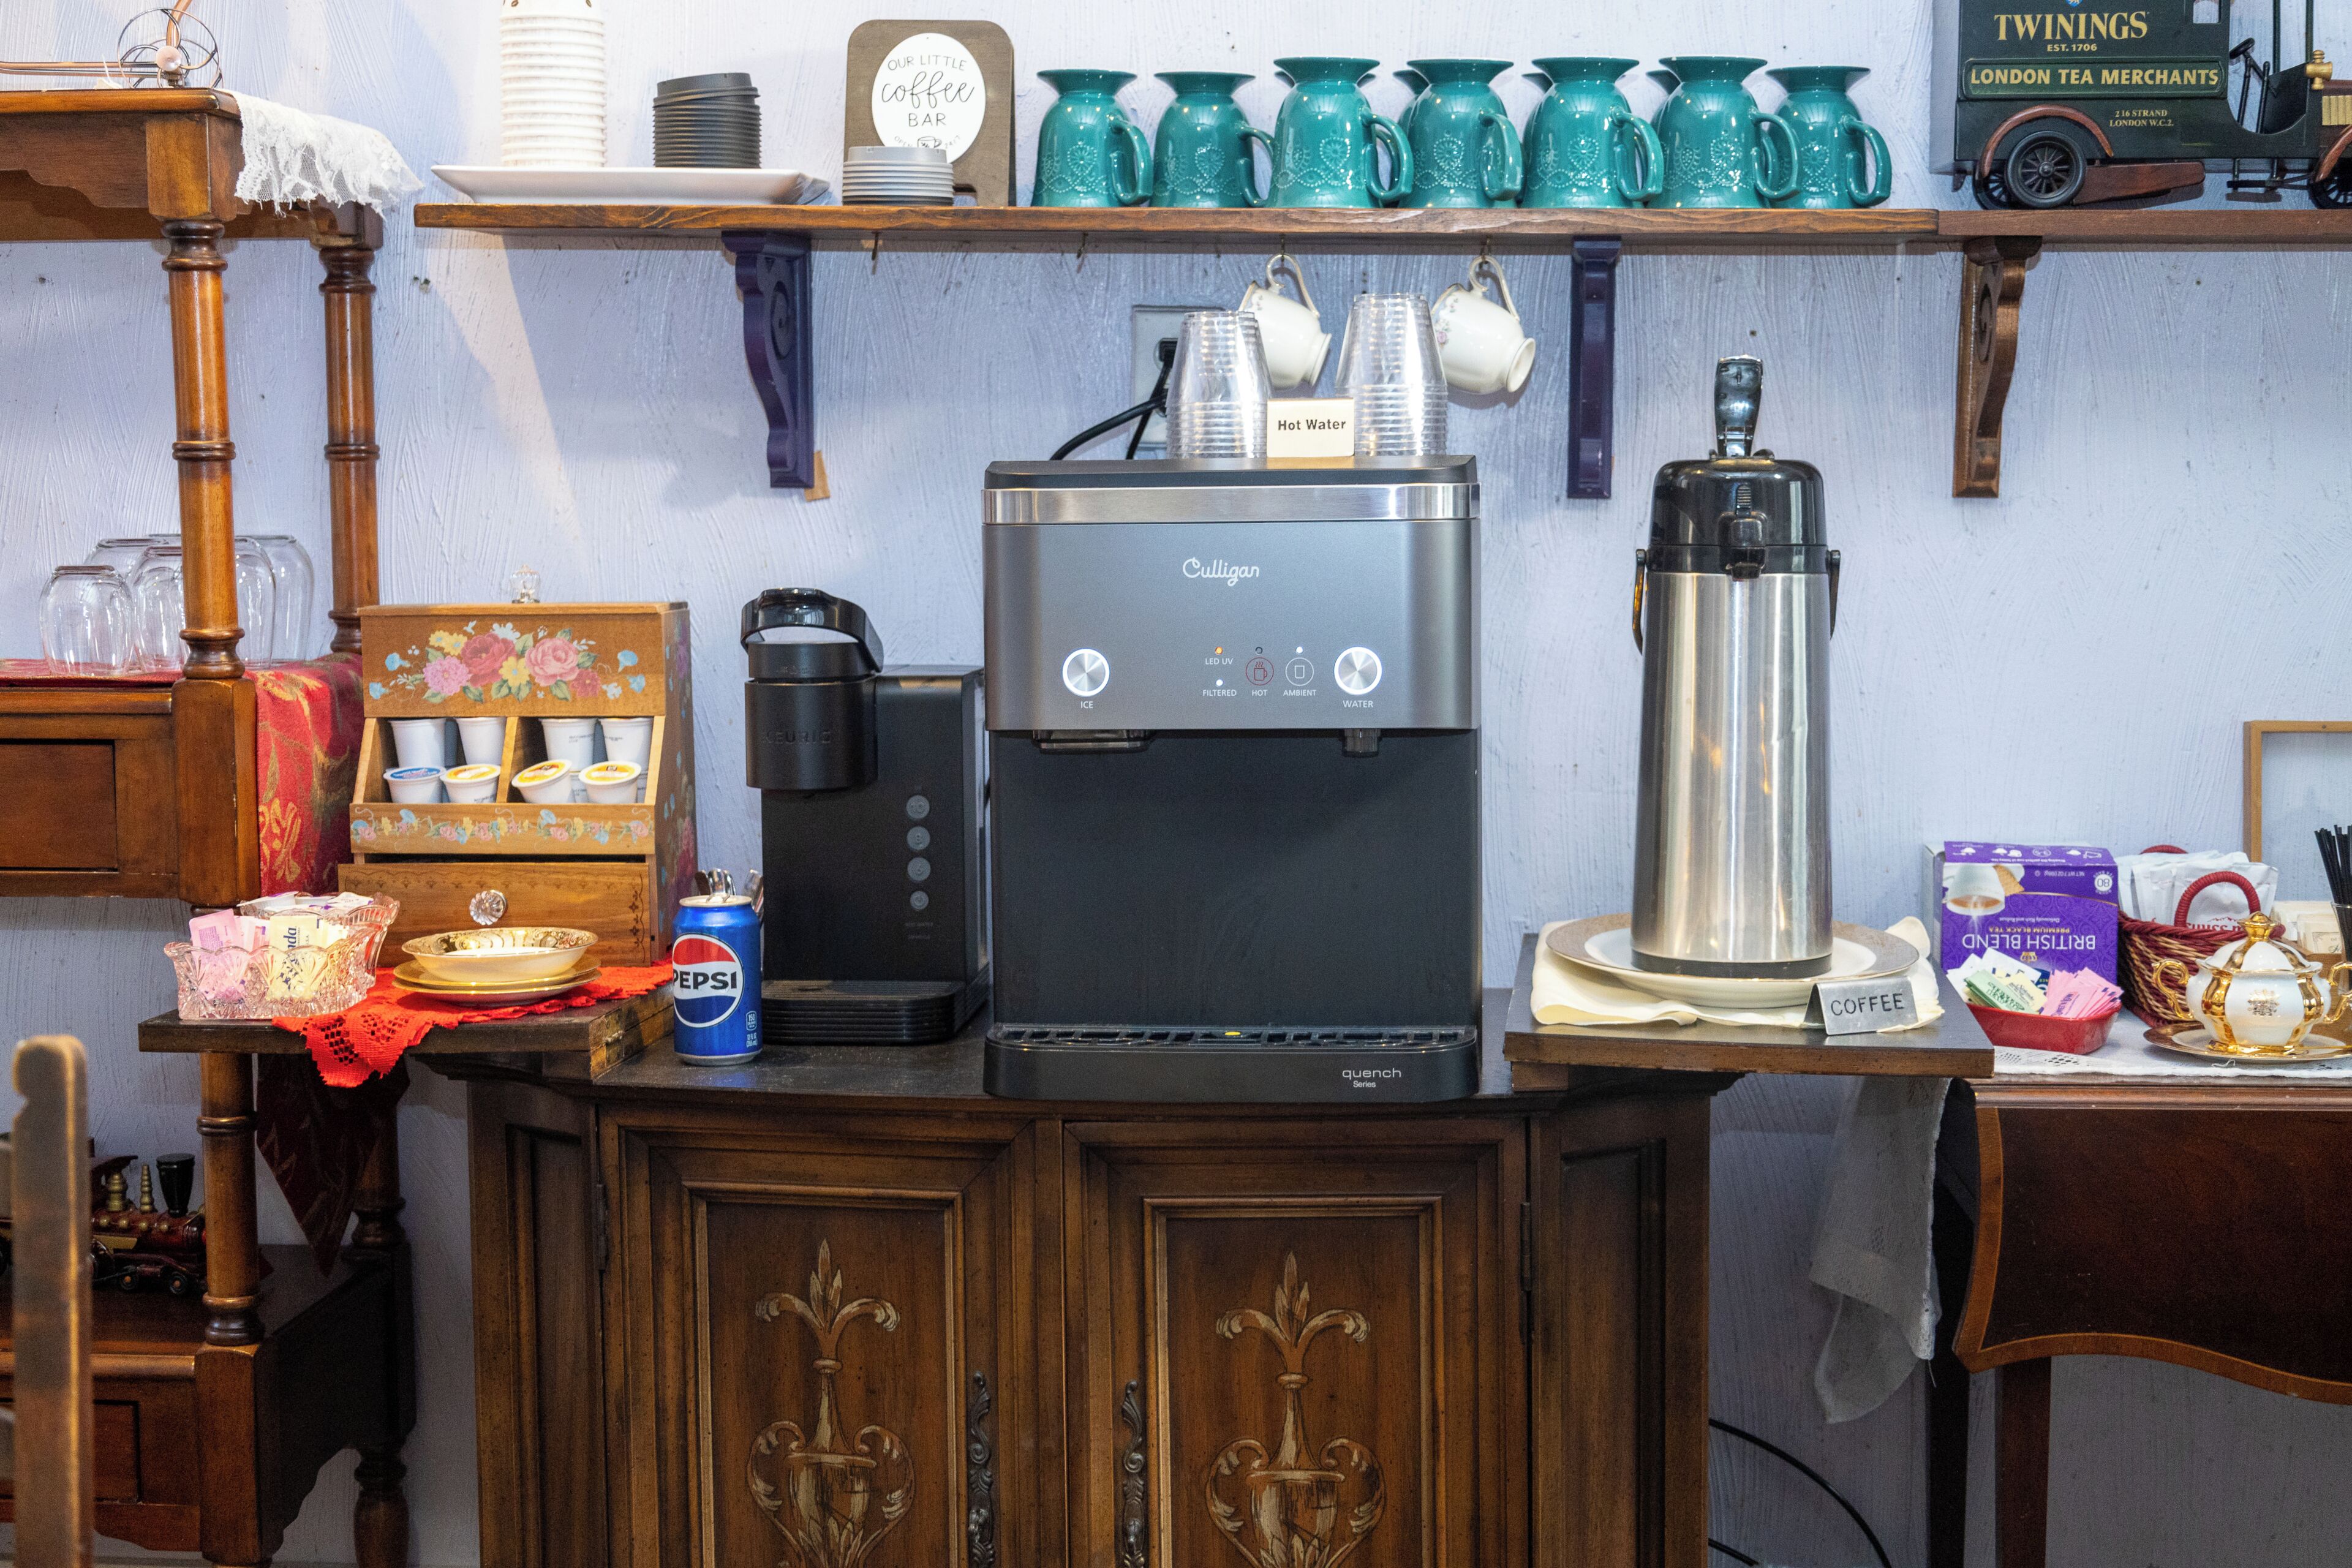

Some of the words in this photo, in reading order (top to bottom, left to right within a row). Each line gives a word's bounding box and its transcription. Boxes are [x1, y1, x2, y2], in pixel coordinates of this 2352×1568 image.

[1994, 11, 2148, 40] TWININGS
[888, 56, 914, 71] OUR
[920, 55, 967, 71] LITTLE
[1970, 69, 2051, 85] LONDON
[2058, 69, 2094, 85] TEA
[2101, 69, 2219, 85] MERCHANTS
[881, 70, 975, 109] coffee
[908, 113, 946, 127] BAR
[2149, 118, 2174, 127] W.C.2.
[1278, 420, 1302, 431] Hot
[1306, 419, 1346, 430] Water
[1182, 557, 1261, 587] Culligan
[1080, 700, 1094, 709] ICE
[1342, 699, 1374, 709] WATER
[763, 729, 834, 745] KEURIG
[2097, 878, 2110, 887] 80
[1962, 933, 2021, 949] BLEND
[2027, 935, 2096, 950] BRITISH
[673, 968, 737, 990] PEPSI
[1831, 993, 1905, 1016] COFFEE
[1342, 1068, 1401, 1080] quench
